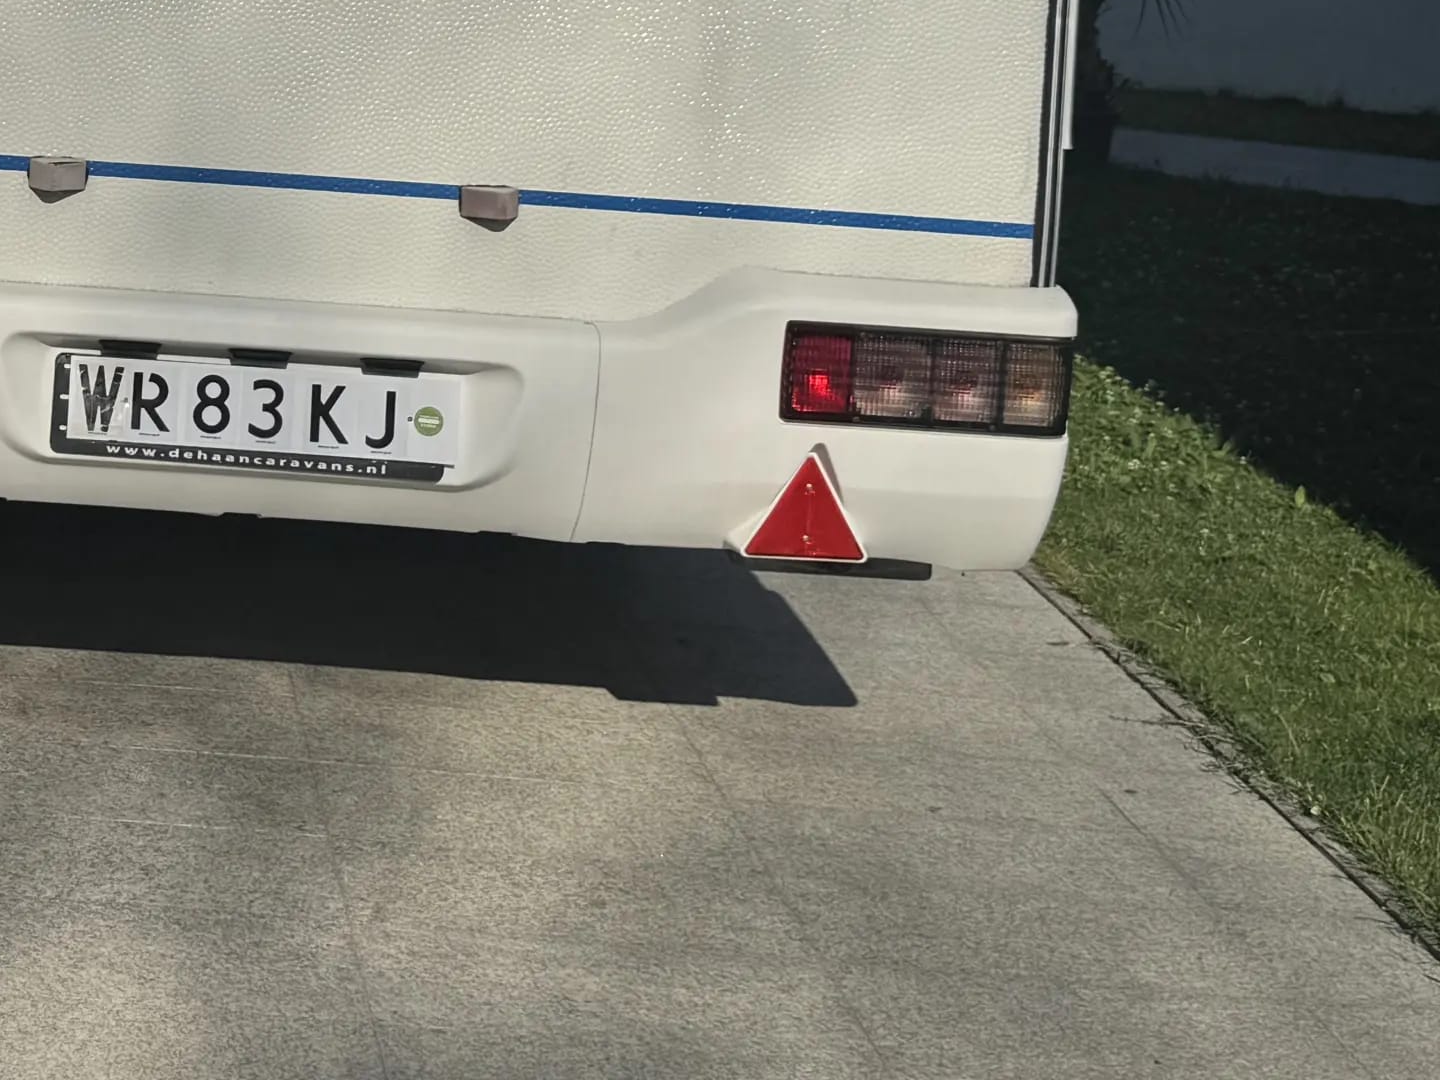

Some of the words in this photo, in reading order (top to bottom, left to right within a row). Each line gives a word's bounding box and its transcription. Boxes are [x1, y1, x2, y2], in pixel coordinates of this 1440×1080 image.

[78, 363, 170, 433] WR
[192, 374, 284, 439] 83
[309, 383, 396, 449] KJ
[105, 444, 387, 475] www.dehaancaravans.nl
